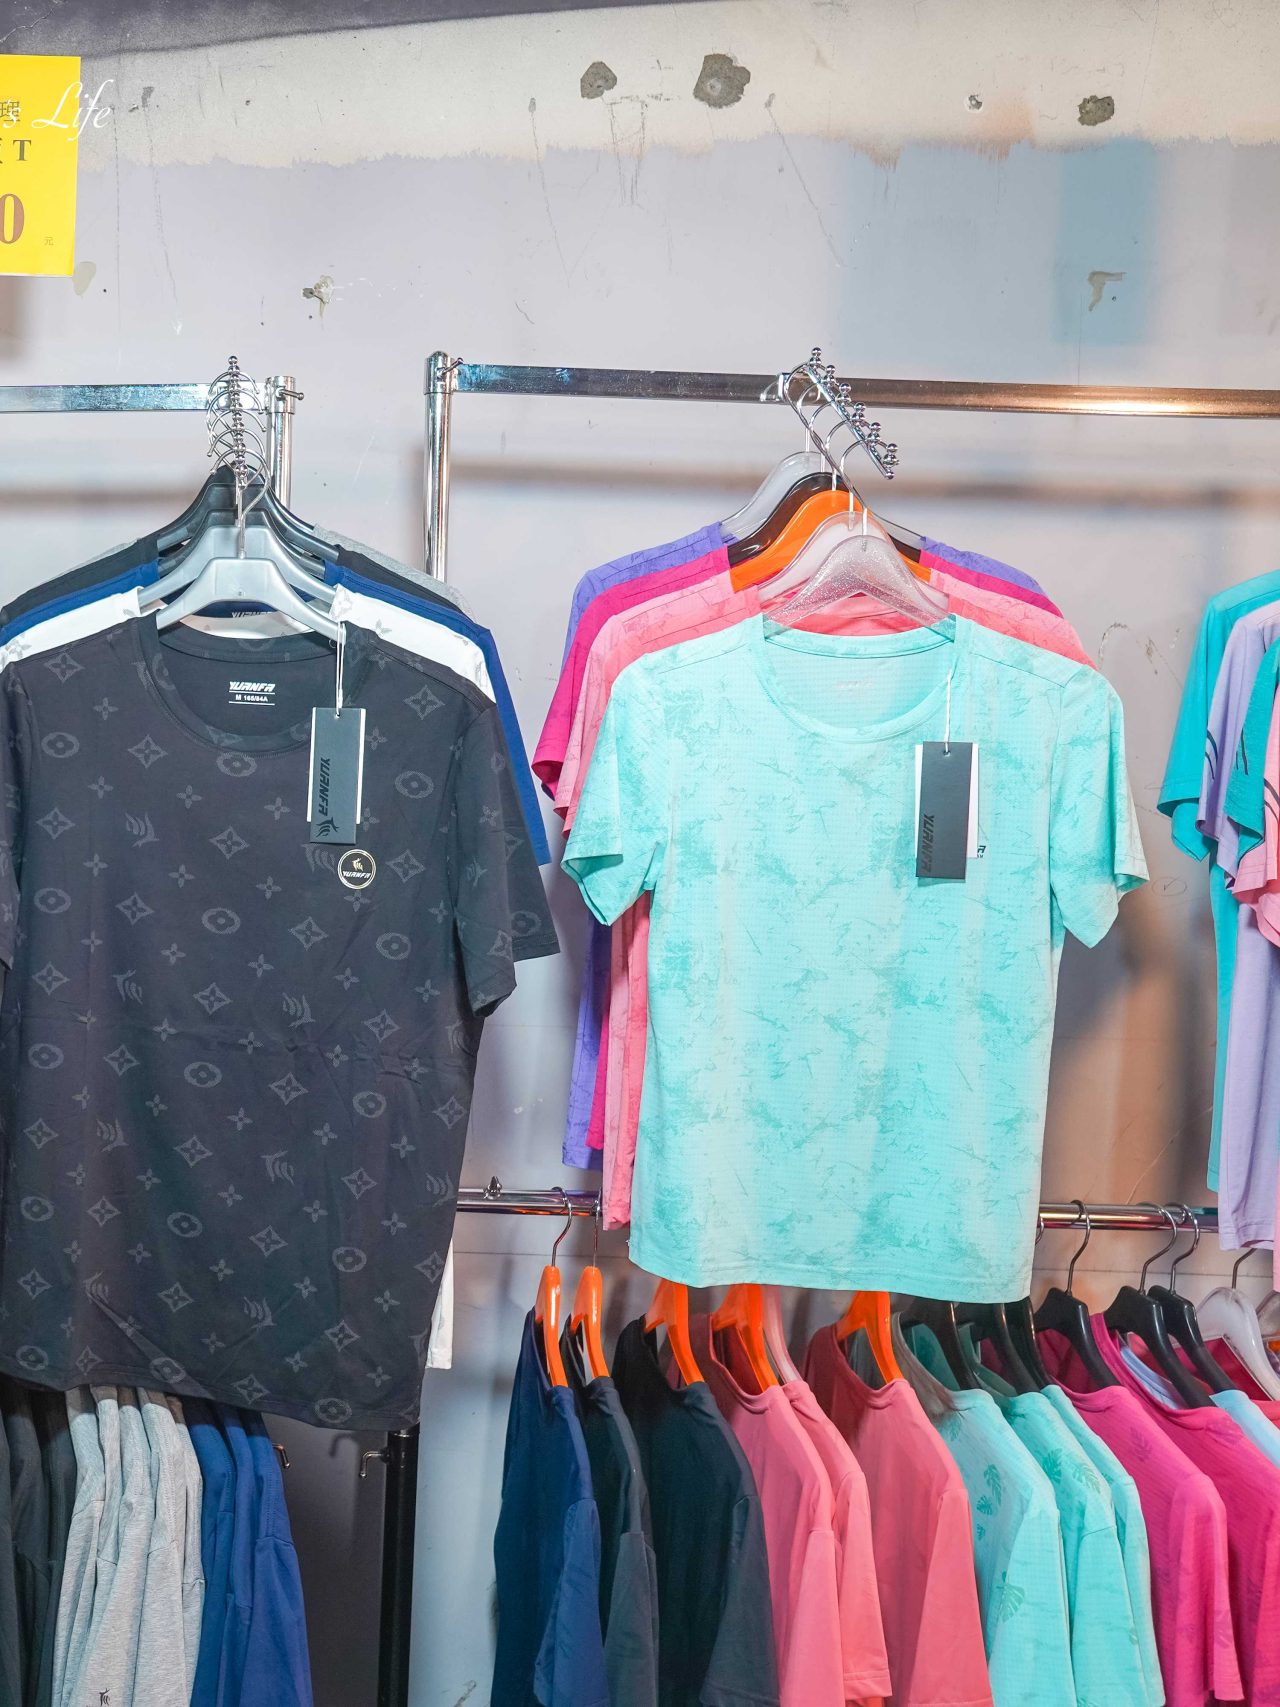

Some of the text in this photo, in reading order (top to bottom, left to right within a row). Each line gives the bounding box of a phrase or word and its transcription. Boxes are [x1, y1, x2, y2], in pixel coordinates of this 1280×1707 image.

[13, 139, 32, 162] T
[229, 681, 276, 692] YUANFA
[318, 757, 331, 816] YUANFA
